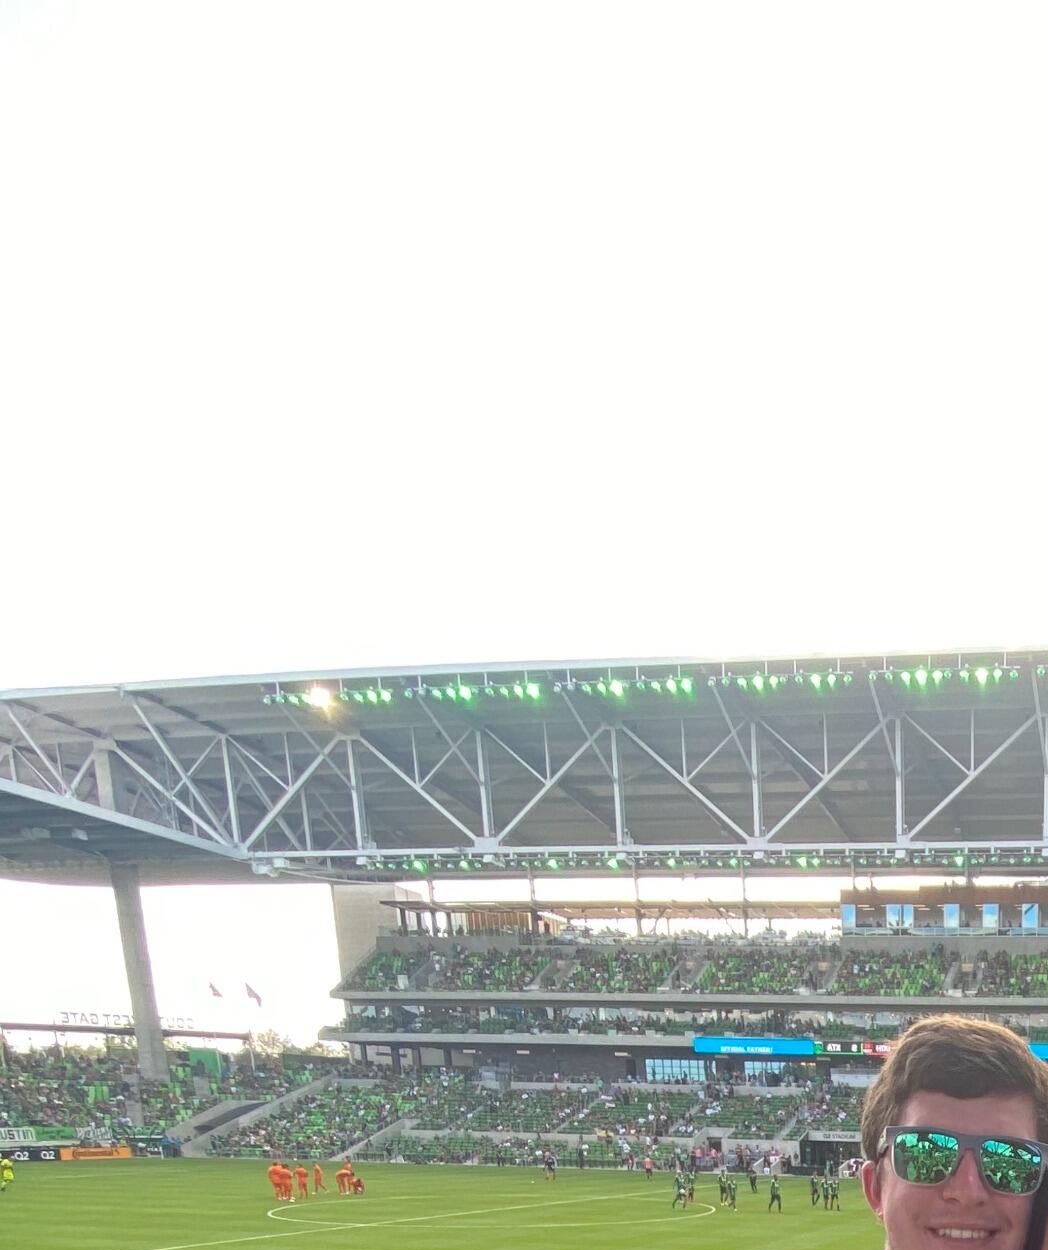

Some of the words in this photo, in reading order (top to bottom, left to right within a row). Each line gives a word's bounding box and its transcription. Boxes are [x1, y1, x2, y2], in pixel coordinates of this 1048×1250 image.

[826, 1043, 841, 1052] ATX
[15, 1151, 30, 1160] Q2
[40, 1151, 56, 1159] Q2
